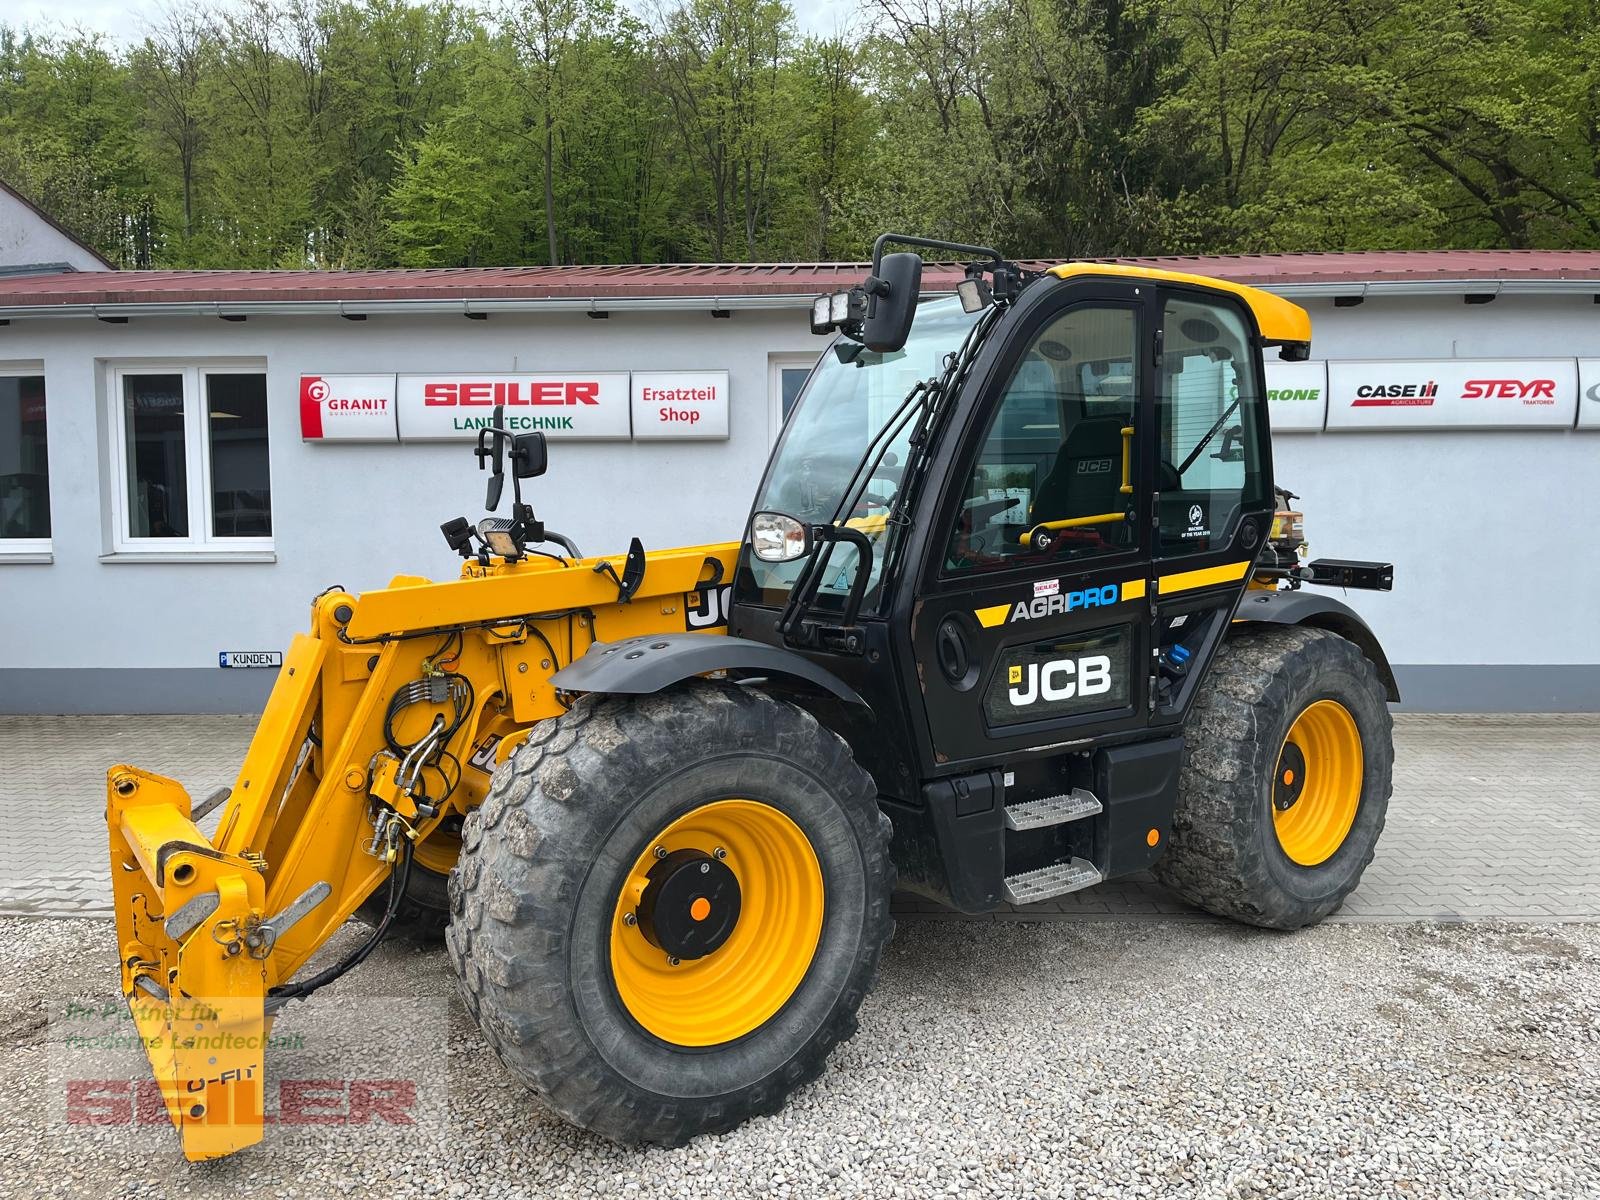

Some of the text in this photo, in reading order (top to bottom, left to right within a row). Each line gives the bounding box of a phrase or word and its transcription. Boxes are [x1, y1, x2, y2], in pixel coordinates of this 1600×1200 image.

[310, 386, 324, 400] G
[425, 383, 600, 406] SEILER
[643, 386, 716, 401] Ersatzteil
[1265, 388, 1321, 401] RONE
[1357, 385, 1417, 398] CASE
[1460, 380, 1556, 399] STEYR
[328, 399, 388, 410] GRANIT
[660, 407, 700, 425] Shop
[1078, 461, 1111, 473] JCB
[1034, 583, 1058, 591] SEILER
[232, 654, 273, 664] KUNDEN
[1009, 655, 1112, 707] JCB
